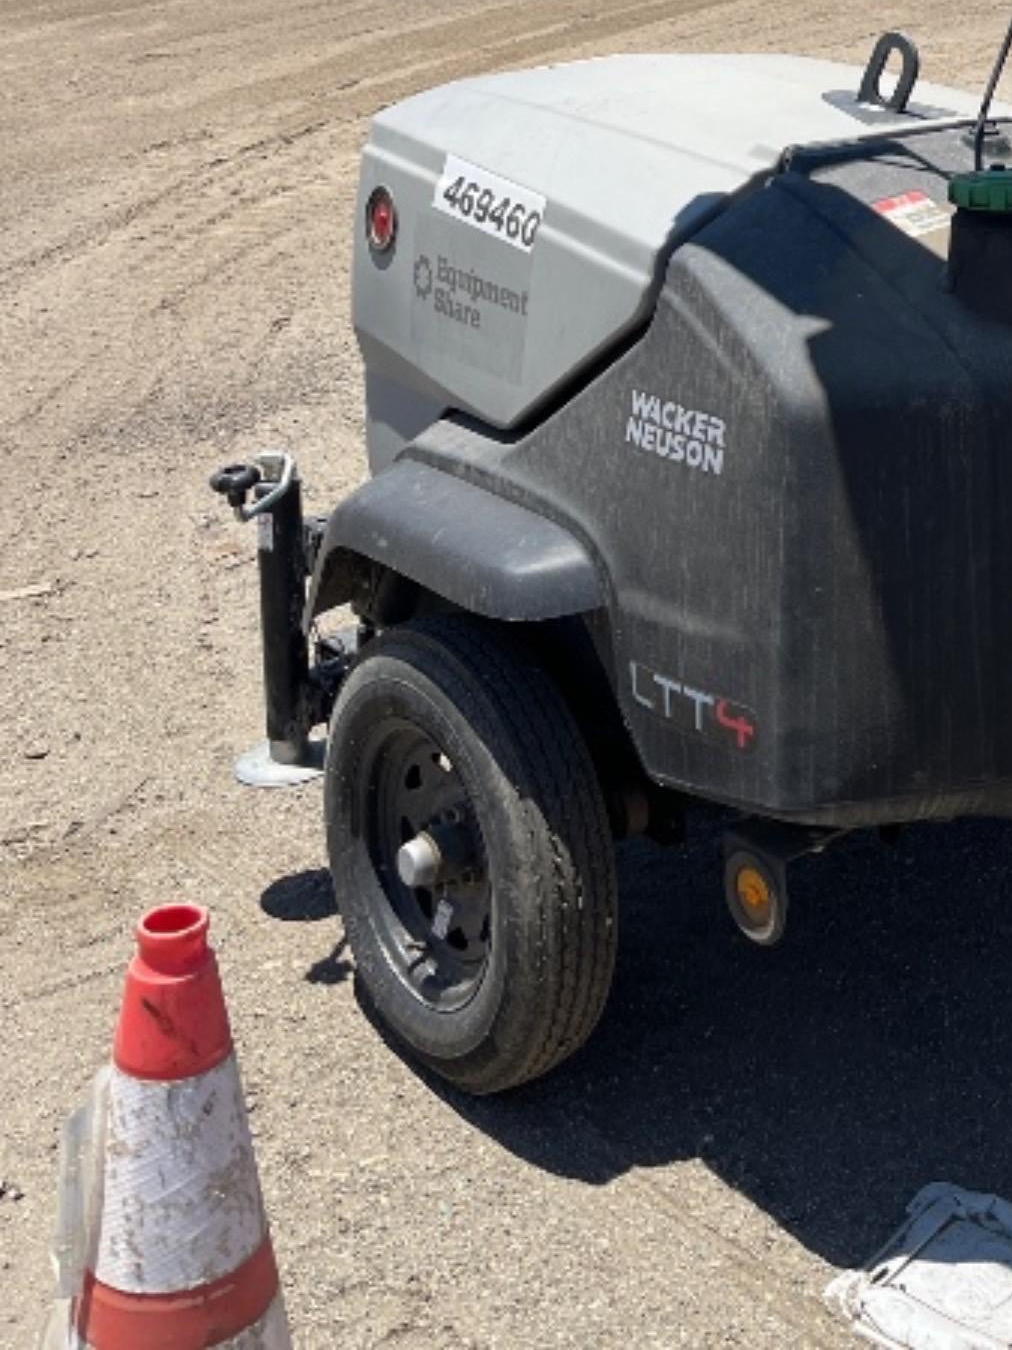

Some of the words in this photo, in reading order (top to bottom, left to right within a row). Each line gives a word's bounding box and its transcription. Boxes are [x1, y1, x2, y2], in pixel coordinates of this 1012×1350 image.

[442, 175, 542, 247] 469460
[433, 287, 481, 330] Share
[437, 254, 529, 316] Equipment
[625, 416, 725, 475] NEUSON
[631, 388, 727, 448] WACKER
[629, 659, 754, 749] LTT4
